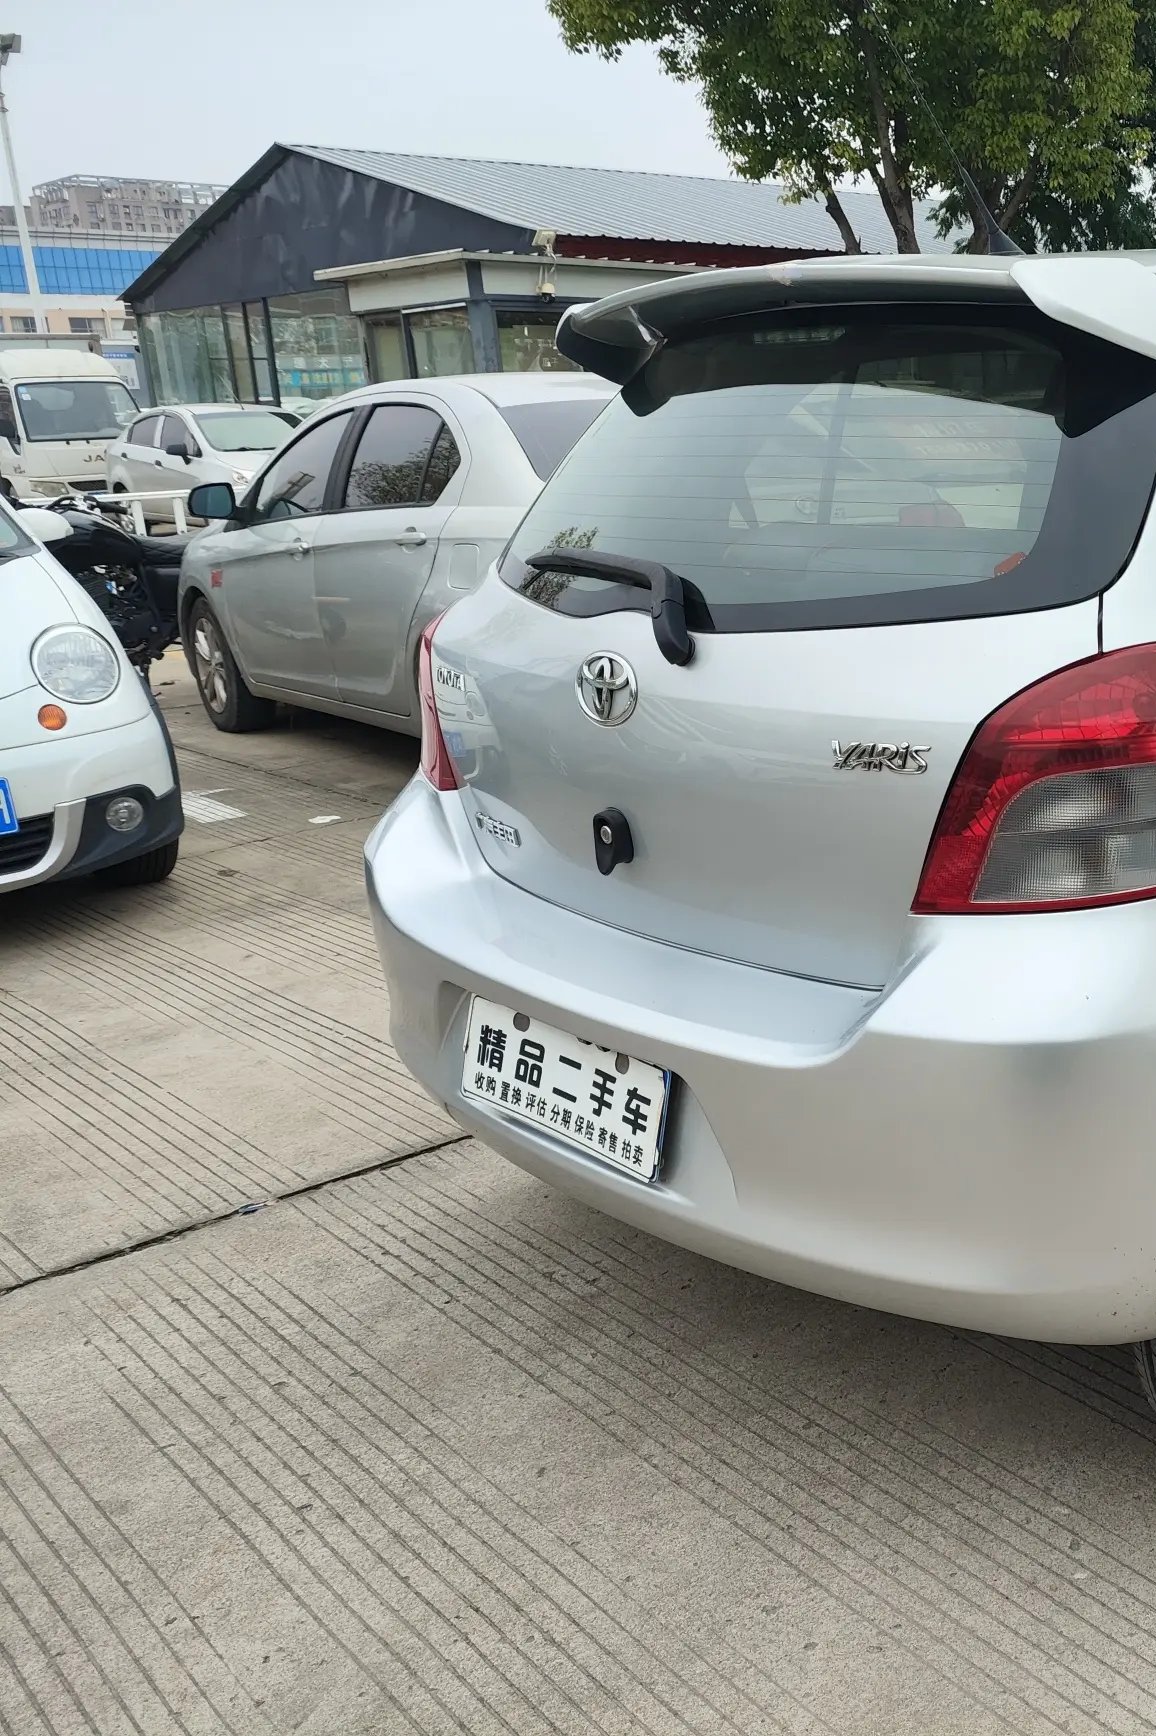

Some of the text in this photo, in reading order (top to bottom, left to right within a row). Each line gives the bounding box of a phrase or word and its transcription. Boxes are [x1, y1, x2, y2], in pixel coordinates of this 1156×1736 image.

[474, 1071, 644, 1168] 收购 置换 评估 分期 保险 寄售 拍卖
[476, 1024, 652, 1136] 精品二手车
